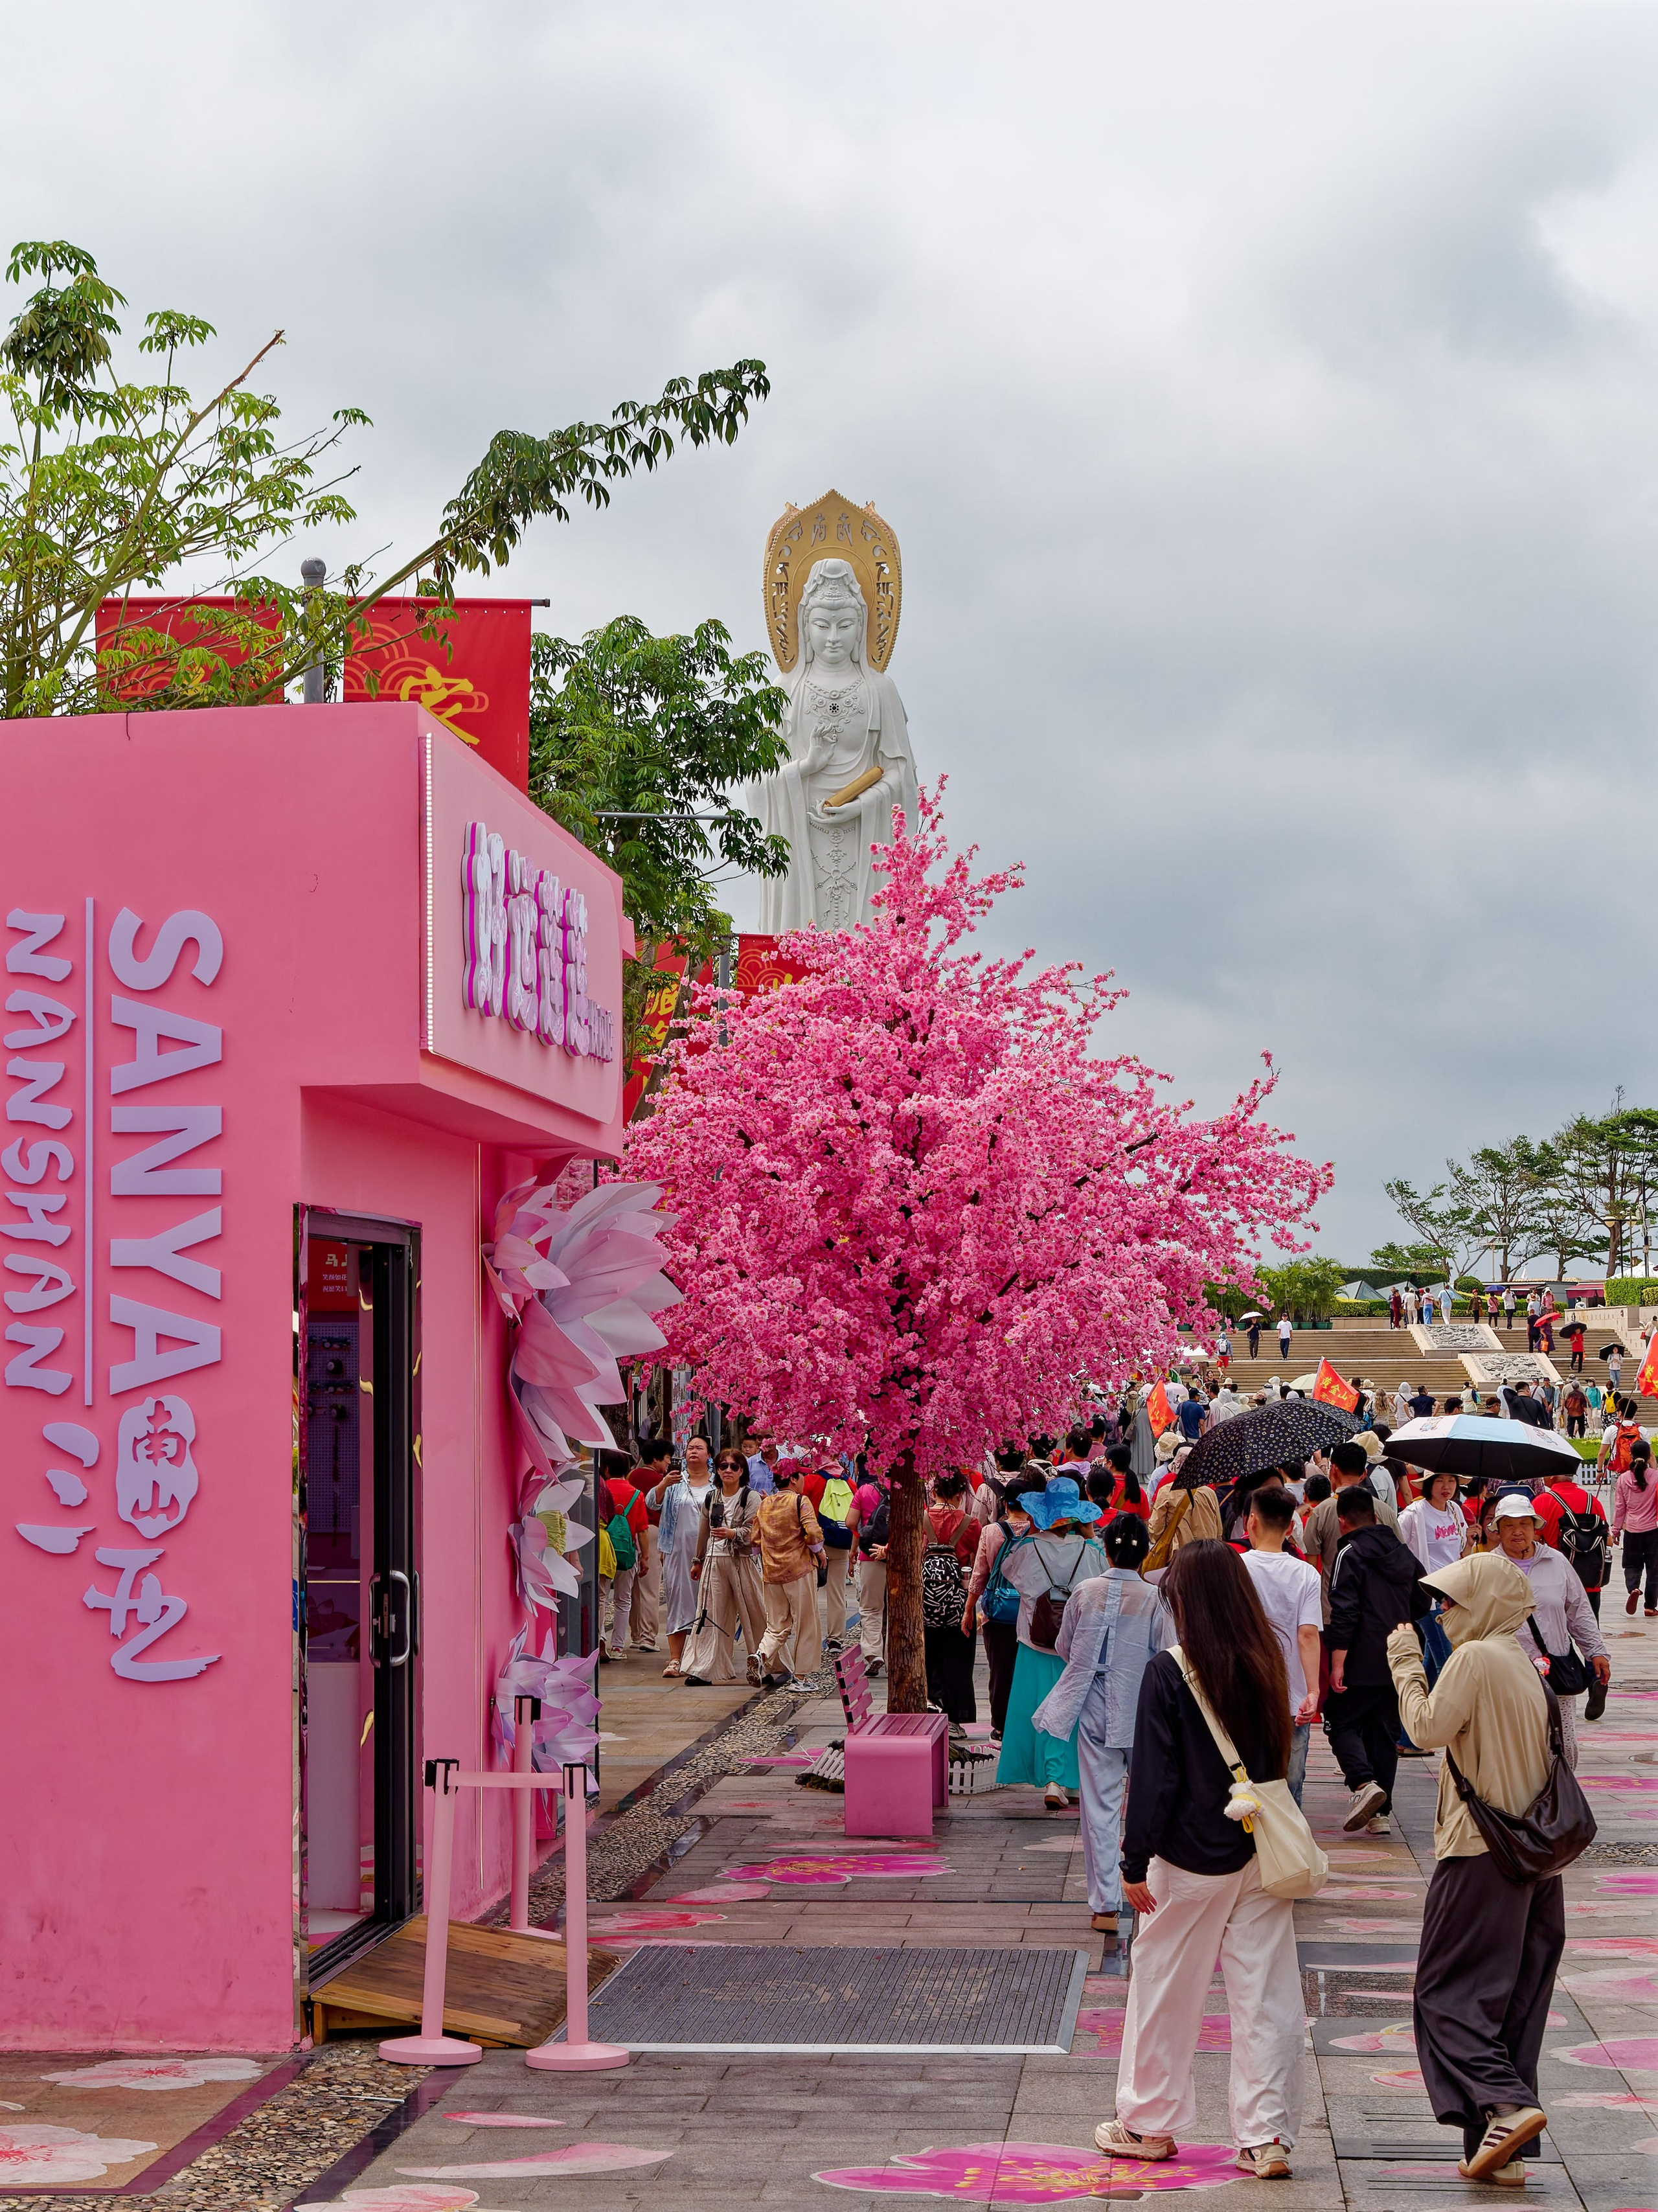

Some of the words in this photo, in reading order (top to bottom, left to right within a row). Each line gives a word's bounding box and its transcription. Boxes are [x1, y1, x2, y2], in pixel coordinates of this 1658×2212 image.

[0, 908, 77, 1395] NANSHAN
[109, 907, 223, 1395] SANYA
[117, 1395, 199, 1539] 南山
[1320, 1376, 1347, 1400] 黄金山
